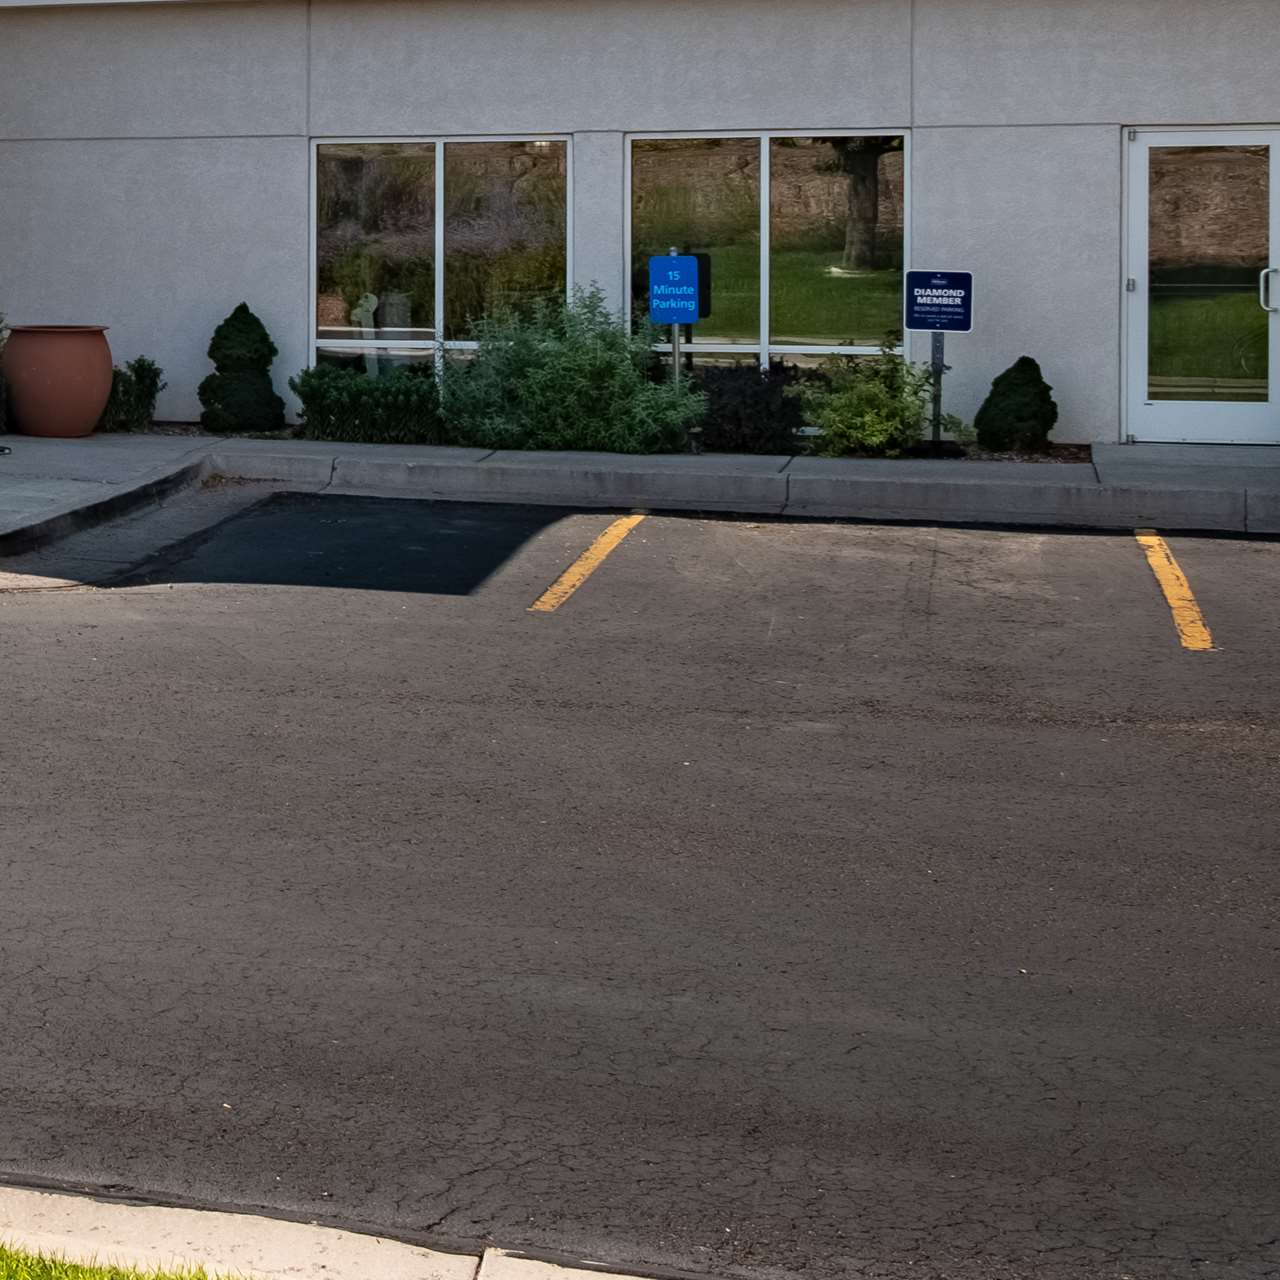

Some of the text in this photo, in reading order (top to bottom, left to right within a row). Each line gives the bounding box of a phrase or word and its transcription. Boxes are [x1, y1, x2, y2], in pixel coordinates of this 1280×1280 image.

[667, 271, 681, 281] 15
[653, 285, 695, 295] Minute
[913, 288, 965, 297] DIAMOND
[652, 300, 696, 311] Parking
[916, 296, 962, 305] MEMBER
